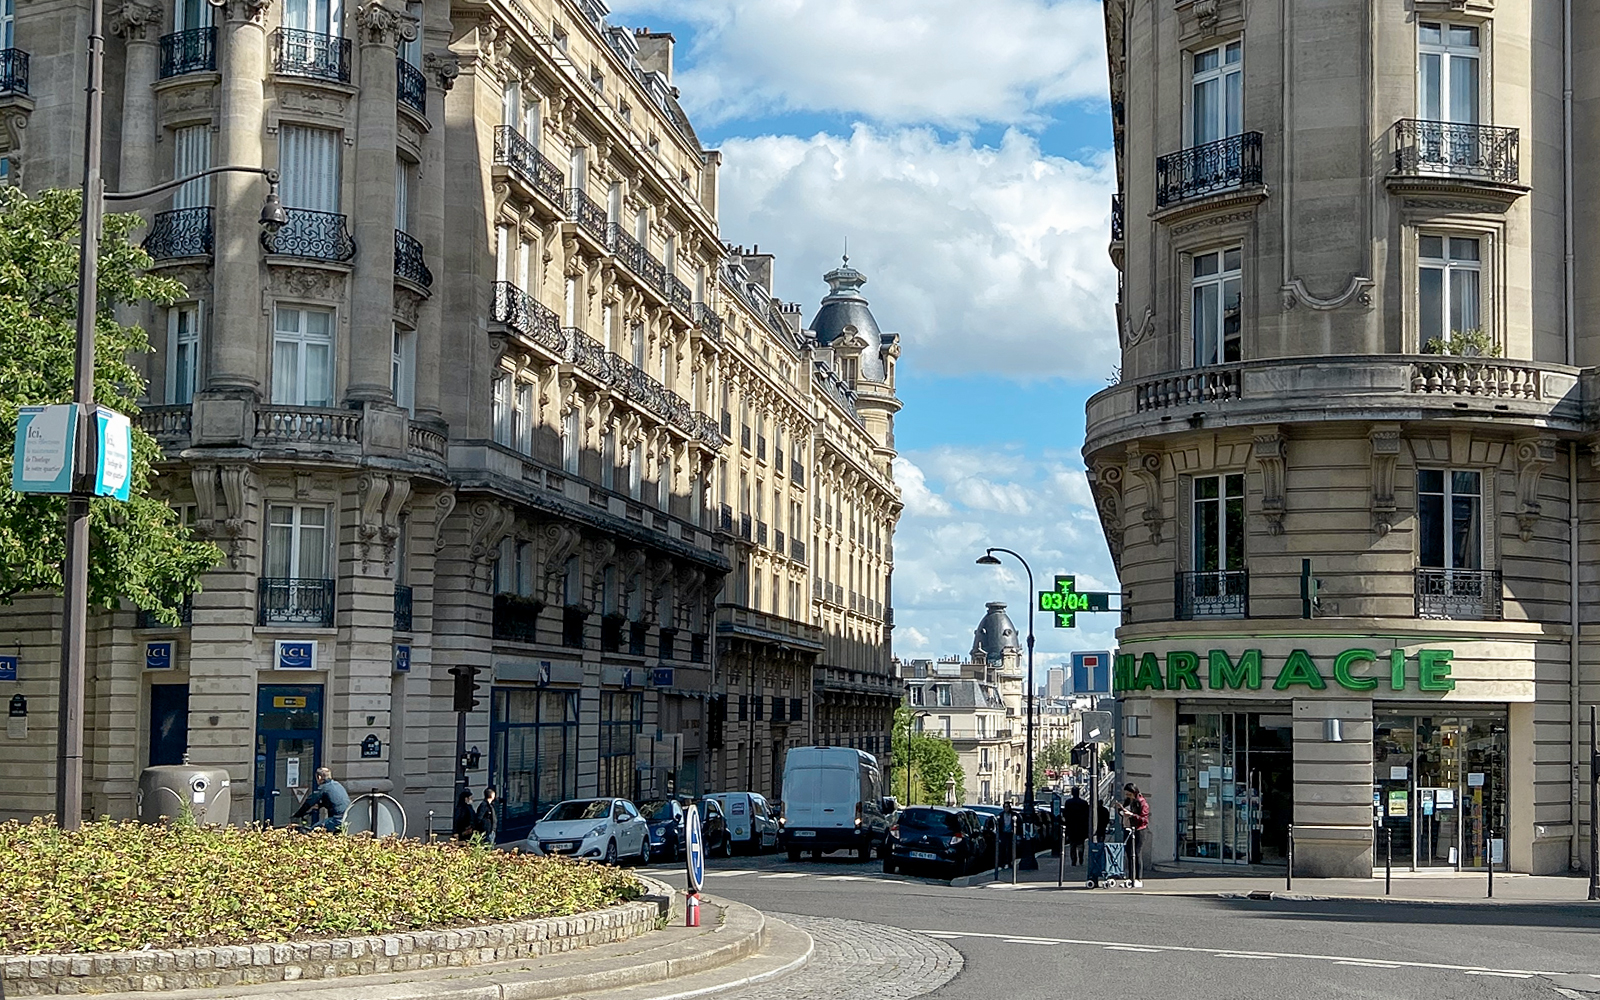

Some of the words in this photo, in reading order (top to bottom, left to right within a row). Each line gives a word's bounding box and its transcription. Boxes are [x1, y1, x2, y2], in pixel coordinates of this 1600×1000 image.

[28, 426, 42, 438] Ici,
[1041, 593, 1089, 610] 03/04
[147, 648, 168, 657] LCL
[282, 648, 309, 658] LCL
[0, 661, 14, 670] CL
[1113, 648, 1455, 691] HARMACIE
